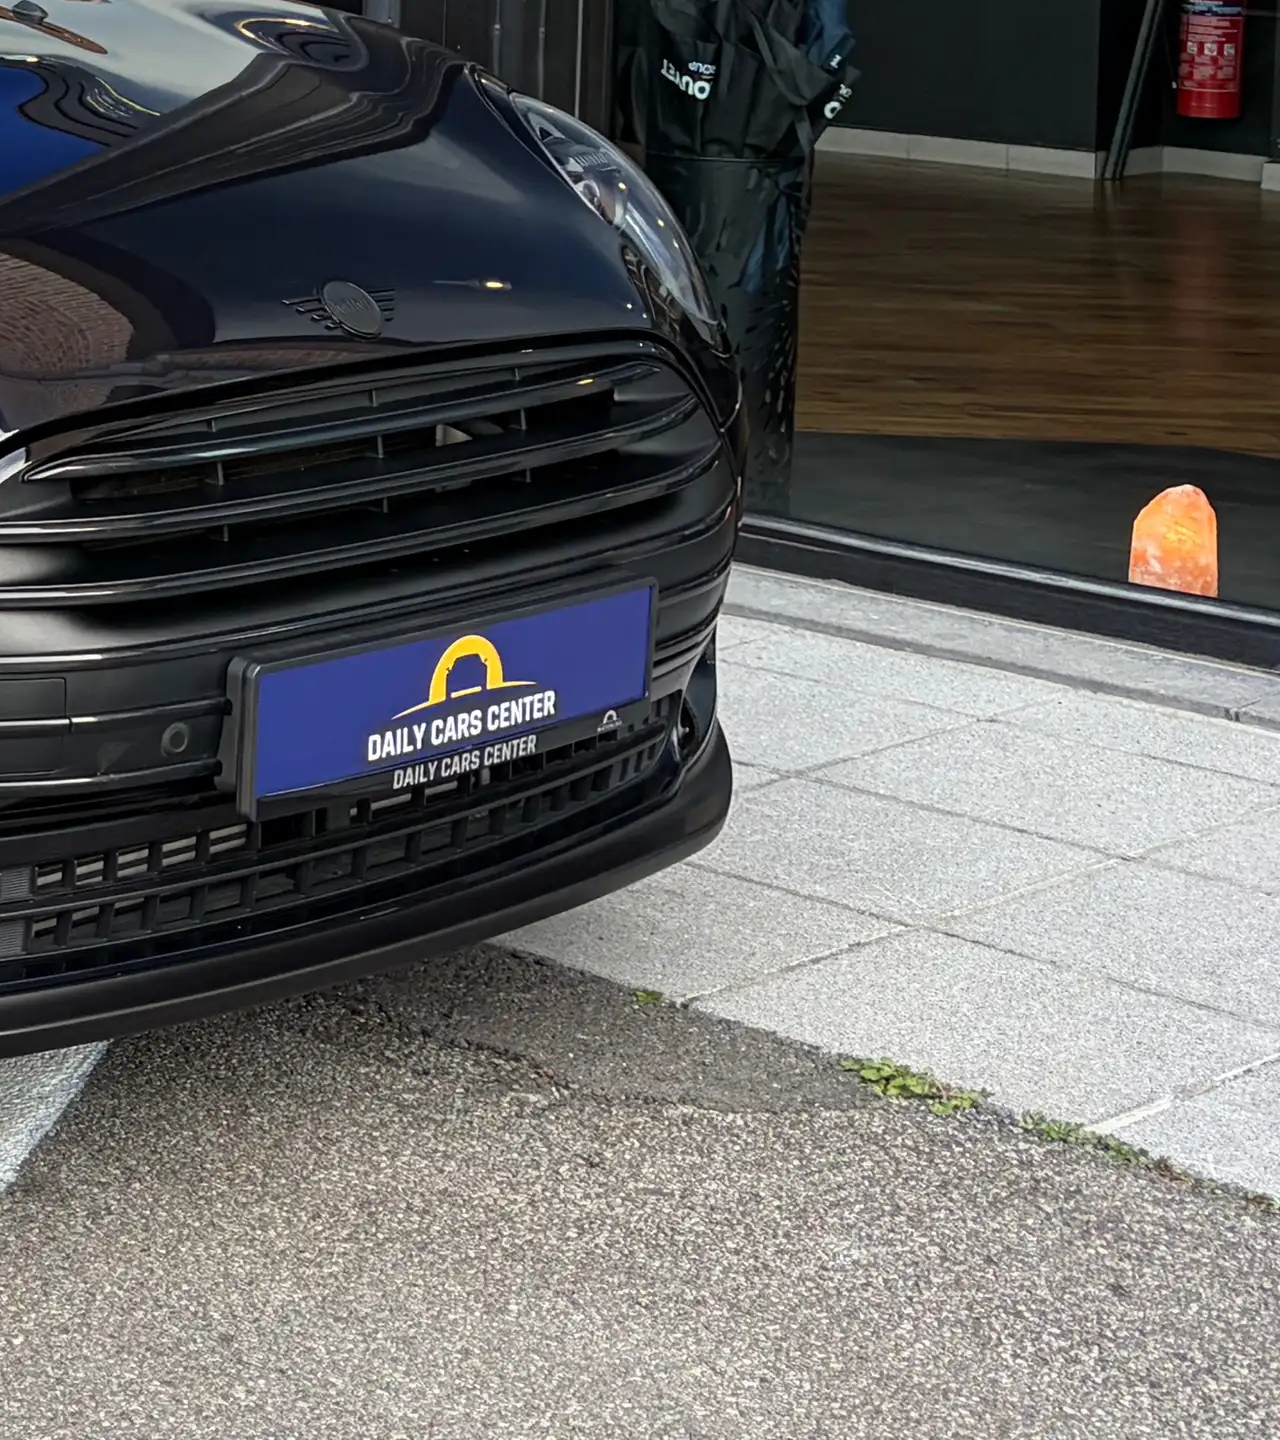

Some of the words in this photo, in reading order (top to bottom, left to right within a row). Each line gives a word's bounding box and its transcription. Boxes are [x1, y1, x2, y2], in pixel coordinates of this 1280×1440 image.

[367, 722, 427, 762] DAILY
[430, 709, 483, 746] CARS
[486, 689, 557, 732] CENTER
[392, 760, 439, 790] DAILY
[440, 750, 481, 778] CARS
[483, 733, 538, 767] CENTER
